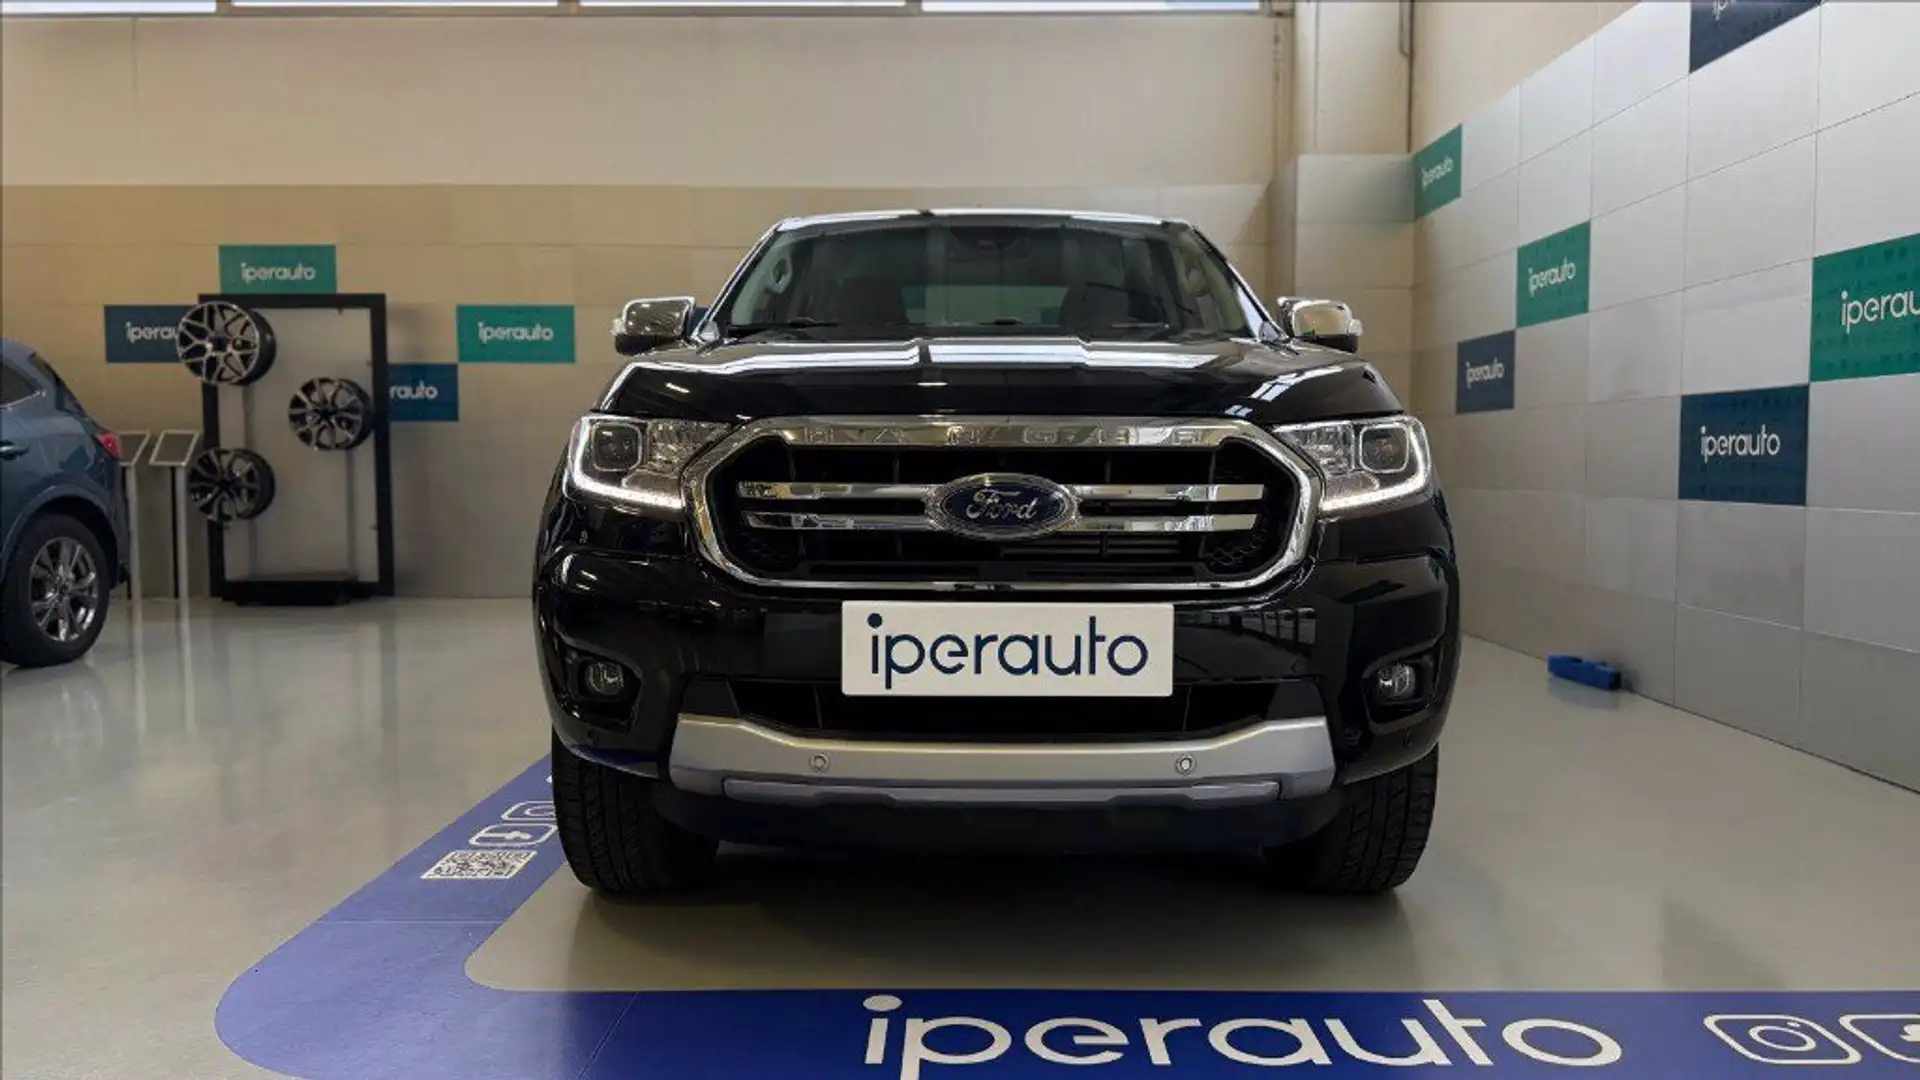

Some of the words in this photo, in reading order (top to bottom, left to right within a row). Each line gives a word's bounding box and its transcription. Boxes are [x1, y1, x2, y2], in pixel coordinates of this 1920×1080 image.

[241, 262, 316, 284] iperauto
[1528, 257, 1576, 297] iperauto
[477, 321, 554, 344] iperauto
[1466, 358, 1504, 388] iperauto
[390, 379, 438, 399] rauto
[1701, 424, 1780, 463] iperauto
[966, 489, 1038, 519] Ford
[867, 612, 1149, 690] iperauto
[863, 995, 1623, 1080] iperauto
